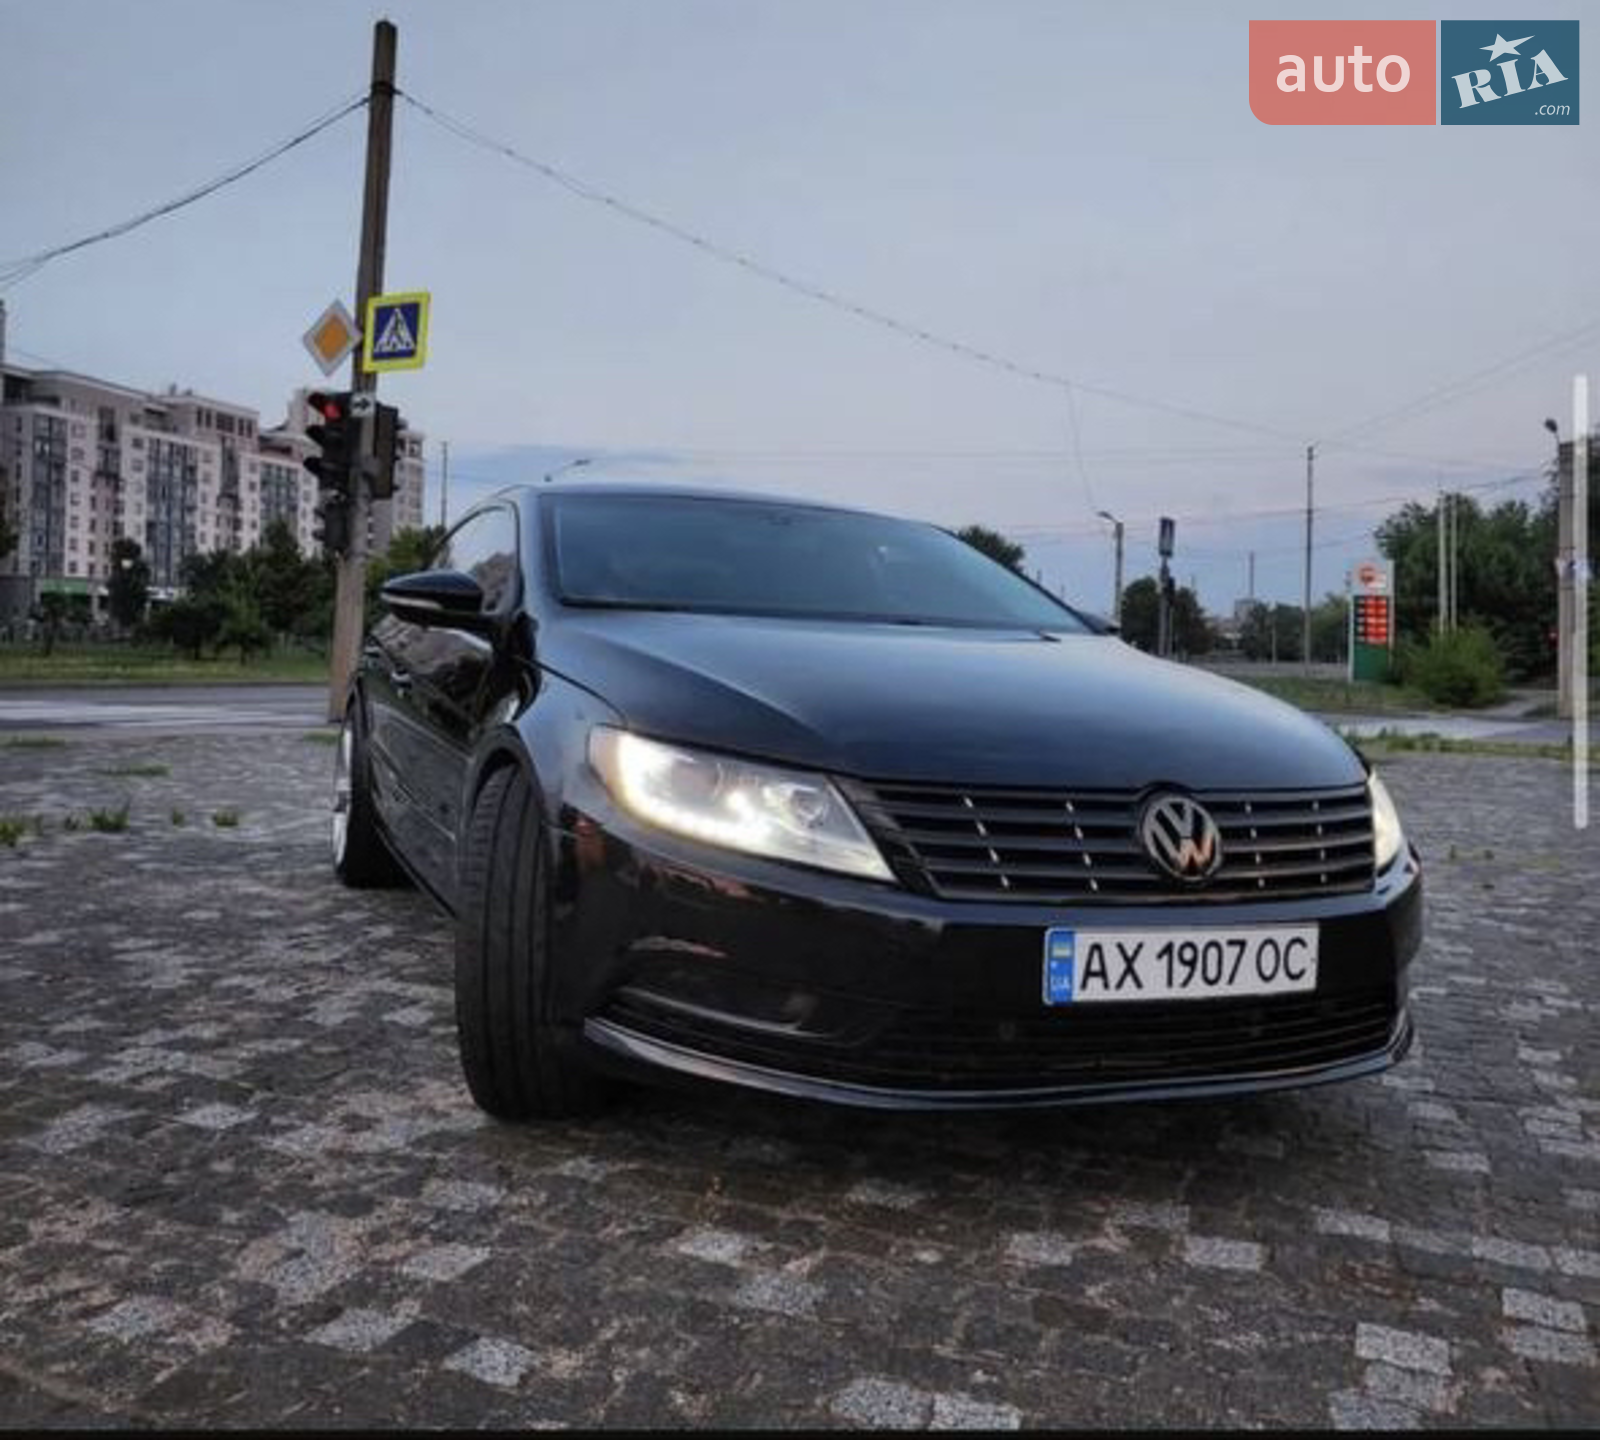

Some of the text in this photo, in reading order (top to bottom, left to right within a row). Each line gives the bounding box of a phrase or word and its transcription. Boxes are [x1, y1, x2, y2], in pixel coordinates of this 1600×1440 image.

[1080, 937, 1308, 990] AX 1907 OC
